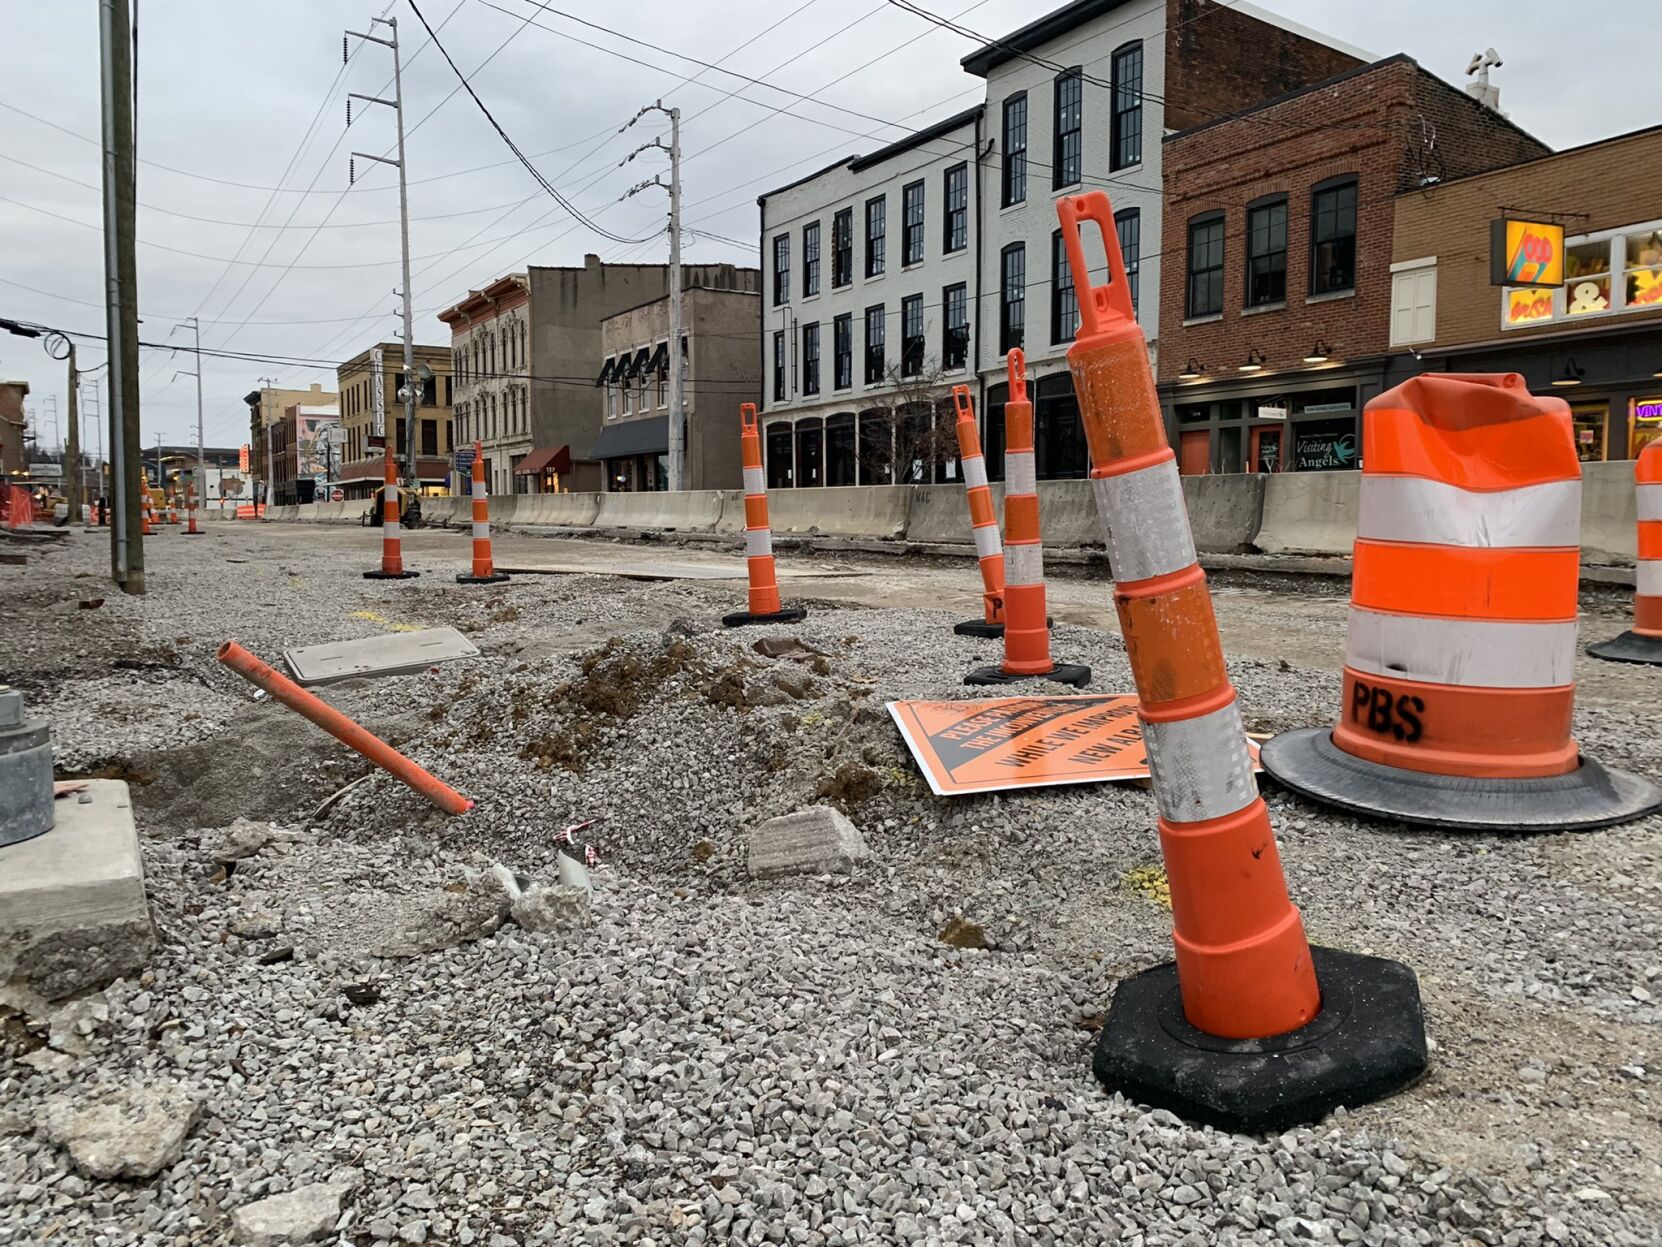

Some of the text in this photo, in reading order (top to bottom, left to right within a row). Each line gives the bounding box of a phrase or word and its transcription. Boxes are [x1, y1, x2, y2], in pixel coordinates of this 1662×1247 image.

[374, 350, 384, 437] CLASSIC
[1297, 440, 1332, 459] Visiting
[1299, 455, 1339, 469] Angels
[1351, 680, 1425, 744] PBS
[939, 714, 1000, 740] PLEASE
[959, 735, 1002, 750] THE
[994, 739, 1066, 767] WHILE
[1045, 726, 1090, 741] WE
[1067, 742, 1123, 765] NEW
